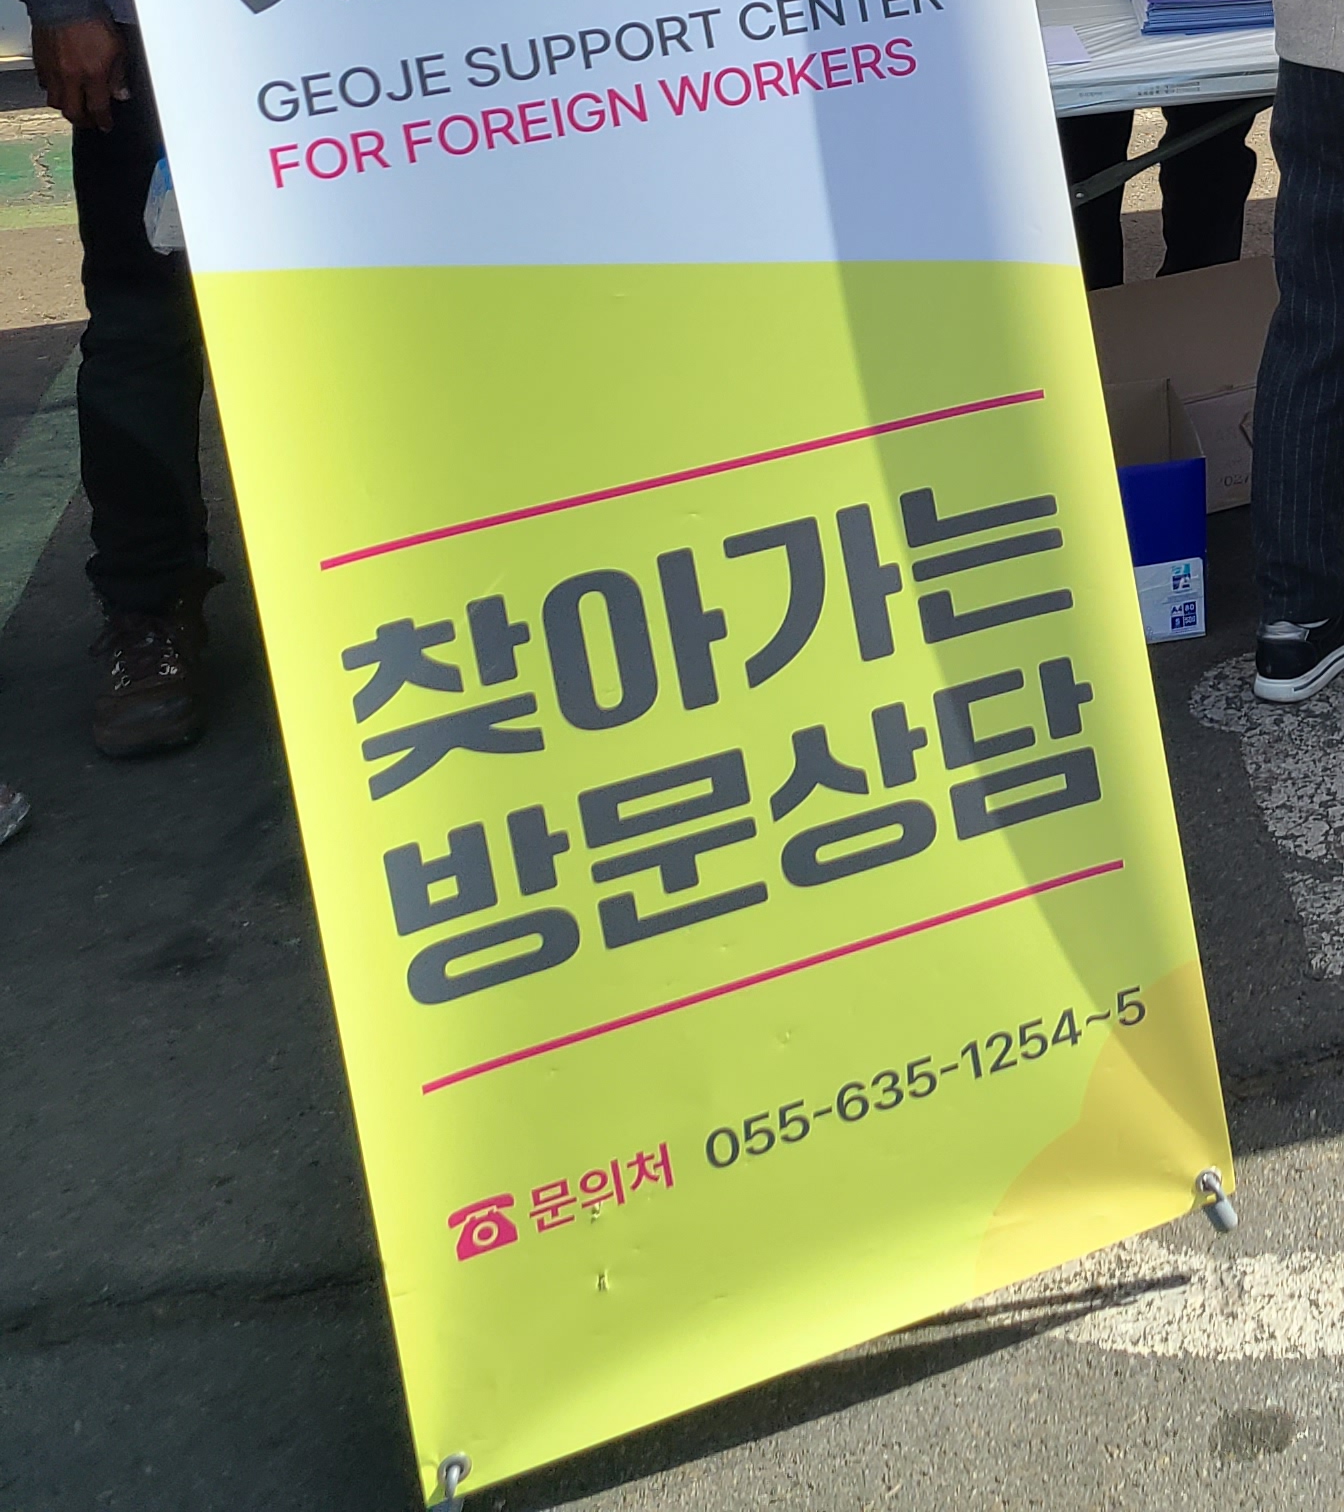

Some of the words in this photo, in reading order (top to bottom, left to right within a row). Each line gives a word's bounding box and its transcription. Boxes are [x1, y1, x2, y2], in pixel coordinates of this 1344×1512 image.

[257, 55, 449, 123] GEOJE
[466, 17, 720, 88] SUPPORT
[269, 129, 390, 188] FOR
[404, 83, 647, 163] FOREIGN
[658, 38, 917, 116] WORKERS
[341, 487, 1073, 802] 찾아가는
[383, 656, 1102, 1005] 방문상담
[527, 1142, 676, 1235] 문의처
[705, 985, 1148, 1170] 055-635-1254~5
